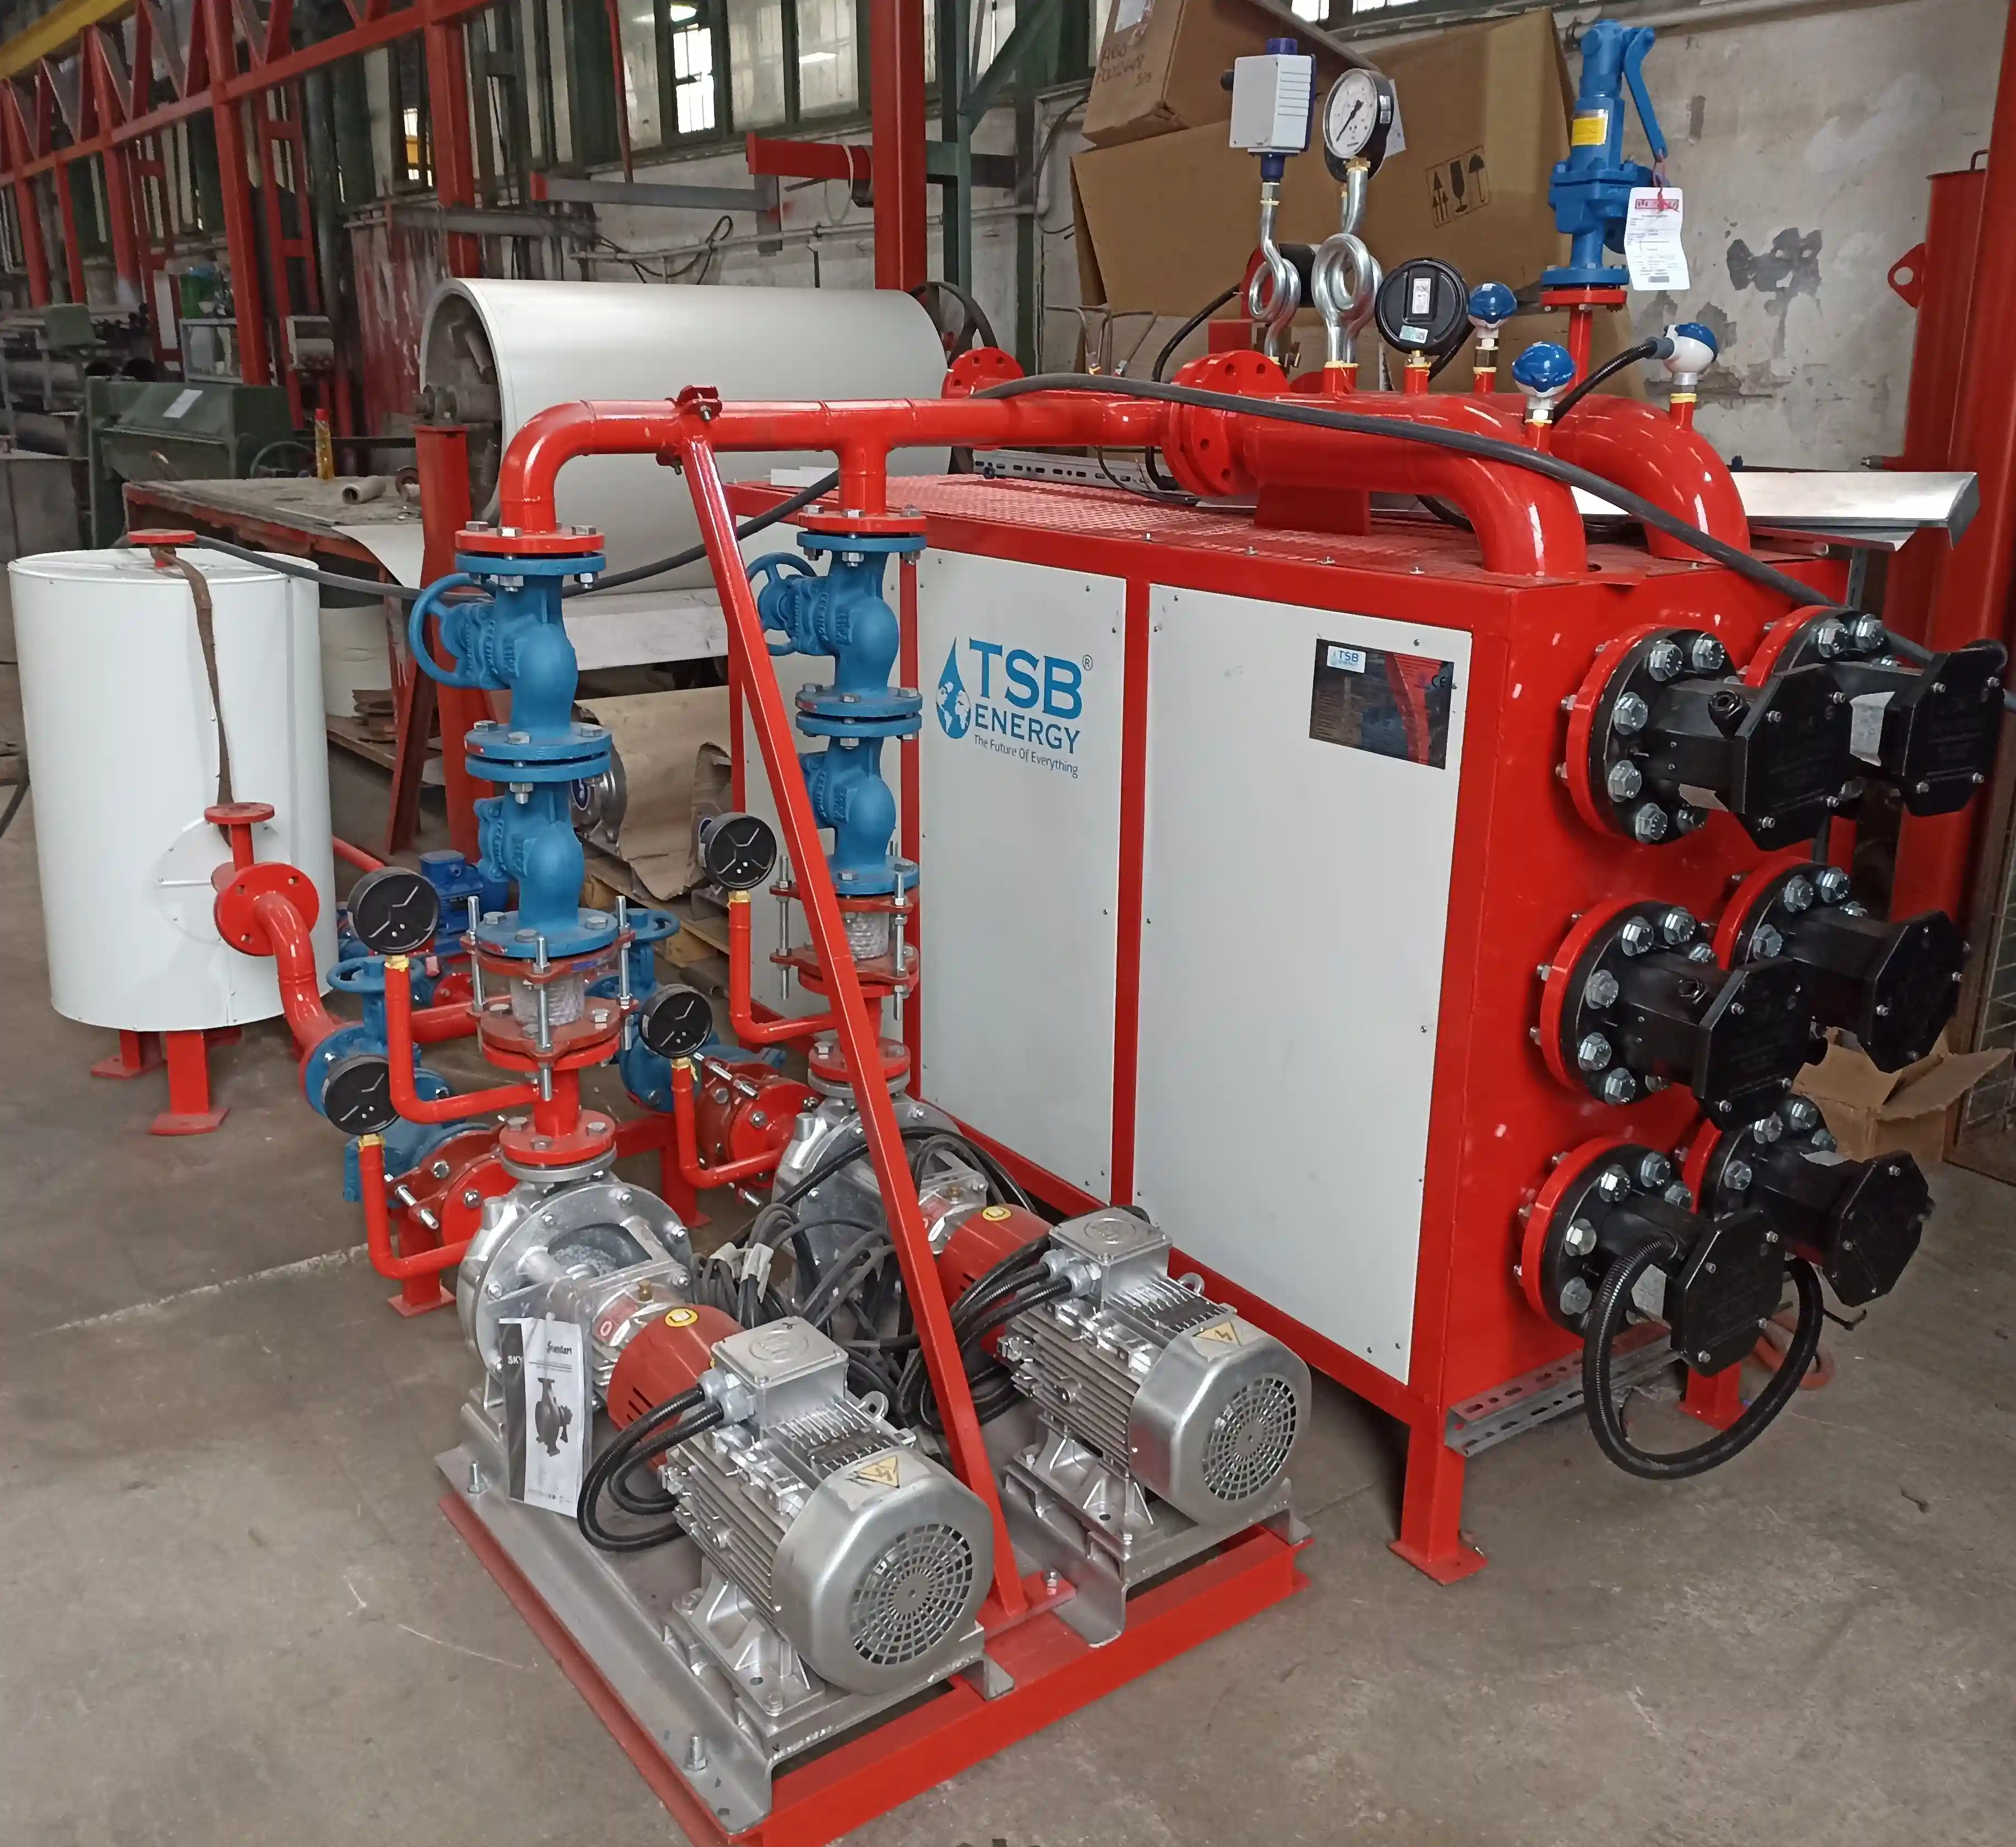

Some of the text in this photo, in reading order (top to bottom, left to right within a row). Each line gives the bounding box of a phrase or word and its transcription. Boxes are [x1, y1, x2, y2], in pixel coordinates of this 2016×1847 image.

[969, 638, 1082, 720] TSB
[1338, 650, 1359, 662] TSB
[975, 703, 1081, 754] ENERGY
[974, 734, 1078, 778] The Future Of Everything
